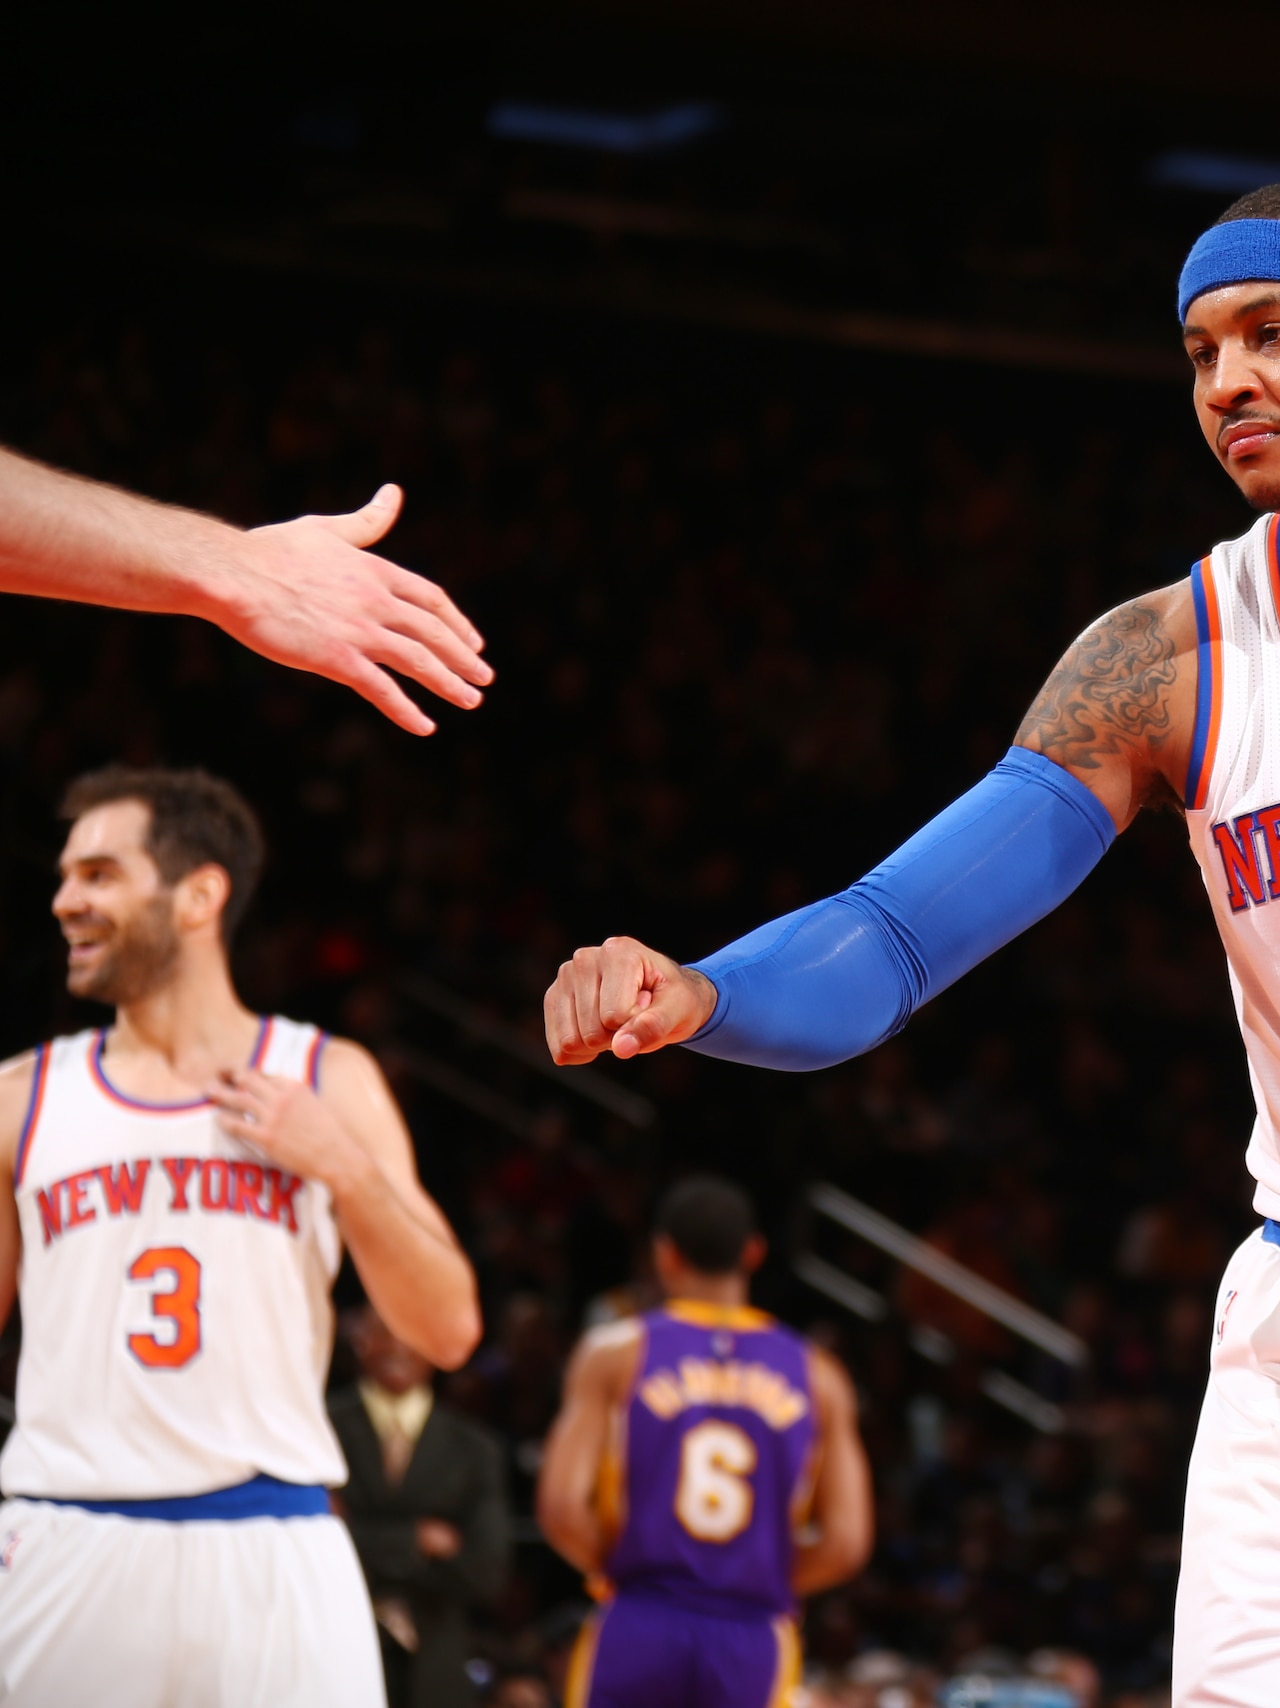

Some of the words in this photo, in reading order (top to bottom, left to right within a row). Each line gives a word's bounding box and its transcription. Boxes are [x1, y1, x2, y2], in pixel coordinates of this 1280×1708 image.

[34, 1158, 152, 1249] NEW
[158, 1157, 305, 1237] YORK
[127, 1245, 203, 1370] 3
[674, 1417, 758, 1545] 6
